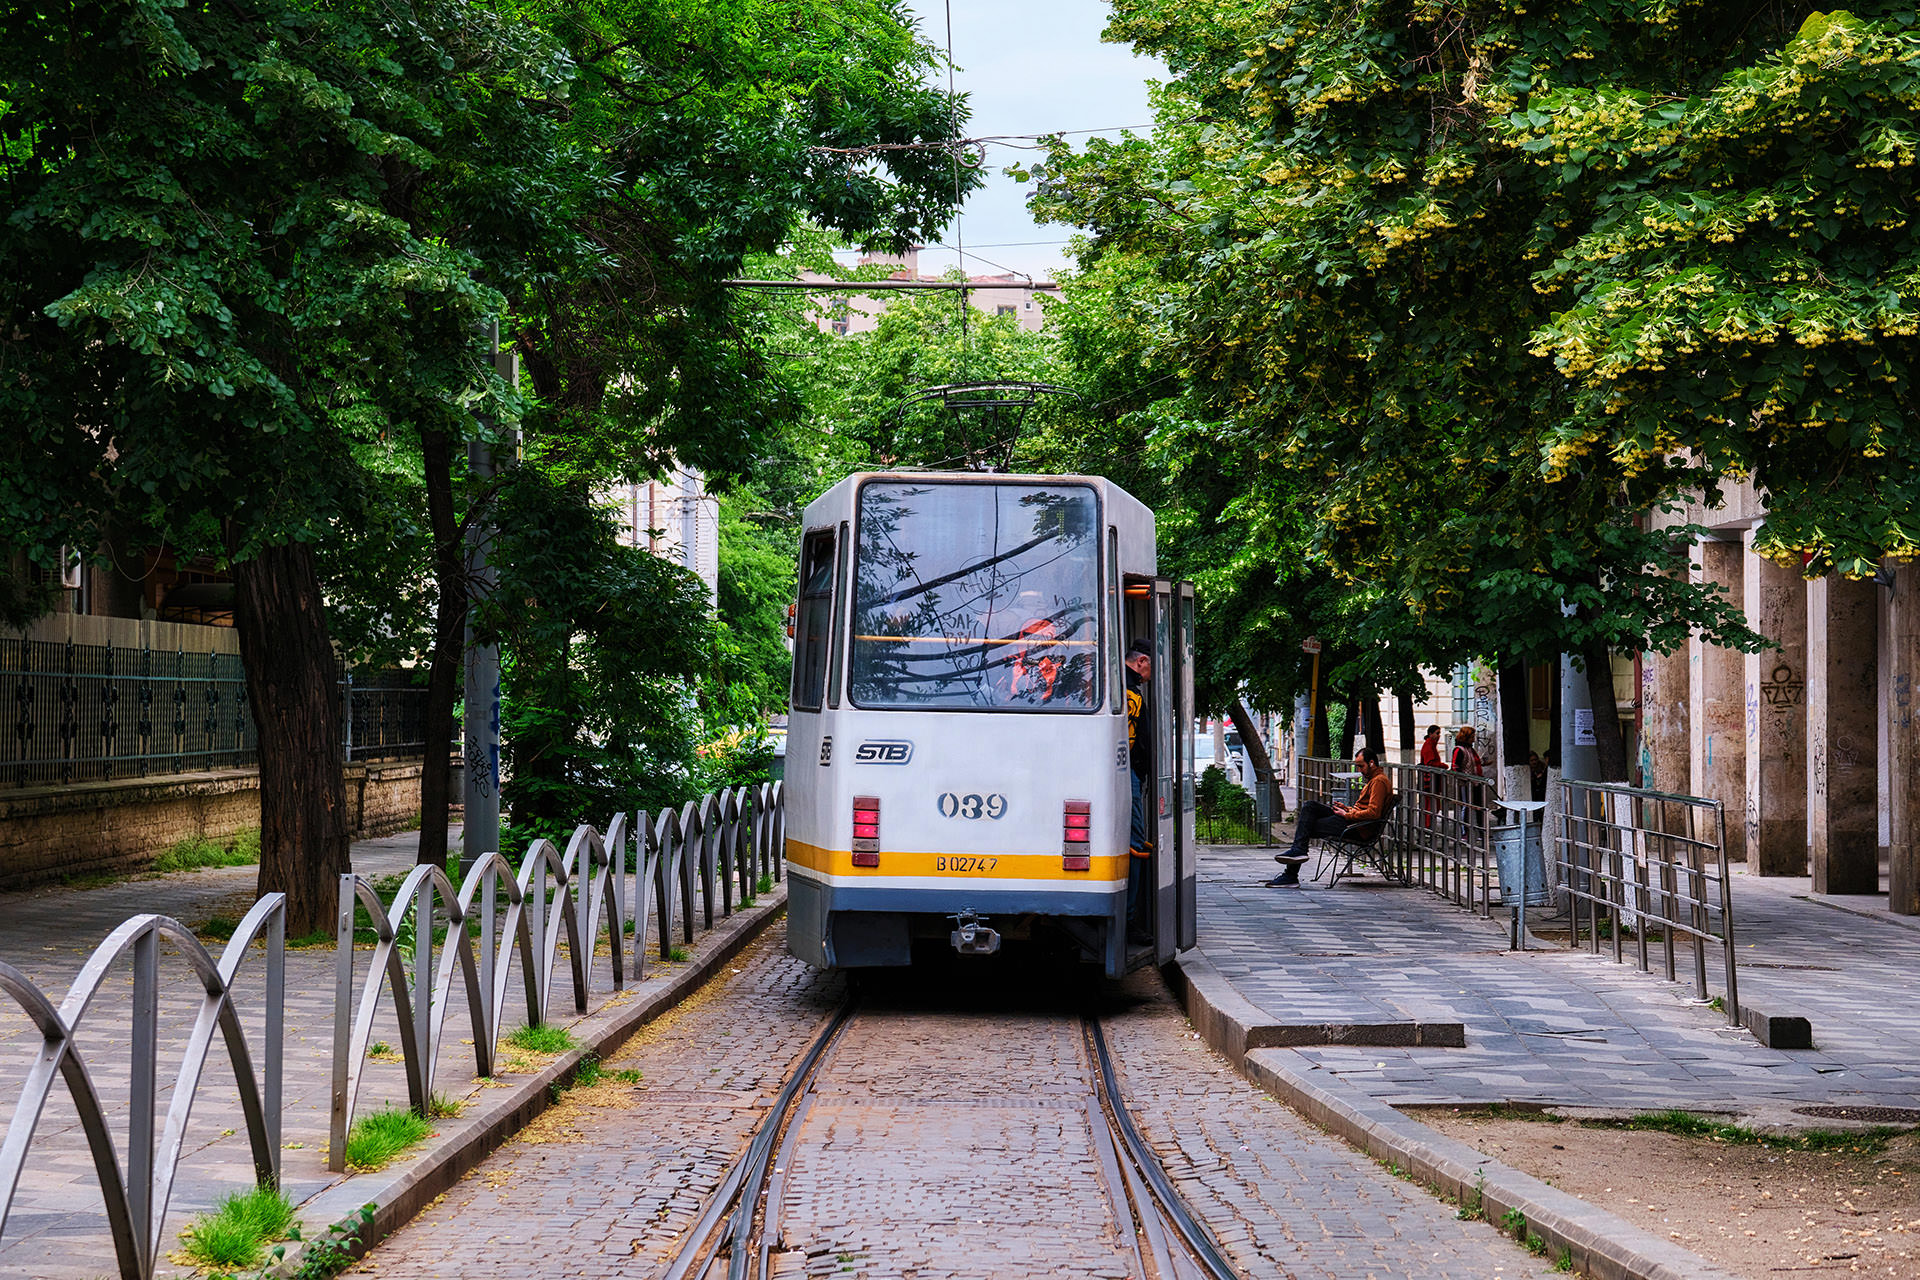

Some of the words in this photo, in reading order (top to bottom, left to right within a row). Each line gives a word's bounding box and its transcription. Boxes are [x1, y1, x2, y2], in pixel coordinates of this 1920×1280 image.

[855, 743, 909, 760] STB
[937, 792, 1008, 820] 039
[937, 857, 946, 871] B
[950, 857, 998, 872] 02747
